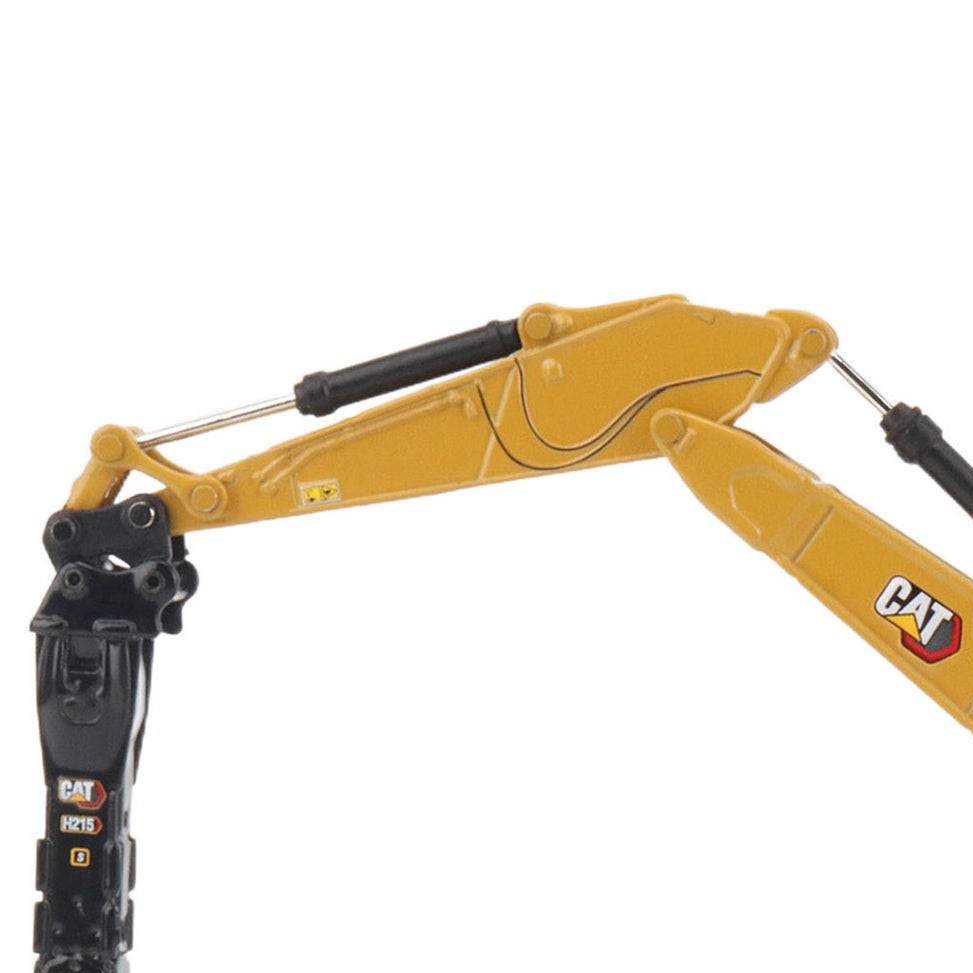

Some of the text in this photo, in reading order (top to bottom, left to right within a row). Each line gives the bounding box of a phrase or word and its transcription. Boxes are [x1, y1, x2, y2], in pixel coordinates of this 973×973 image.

[875, 576, 955, 646] CAT
[60, 779, 94, 802] CAT
[62, 816, 95, 832] H215
[76, 852, 85, 862] S
